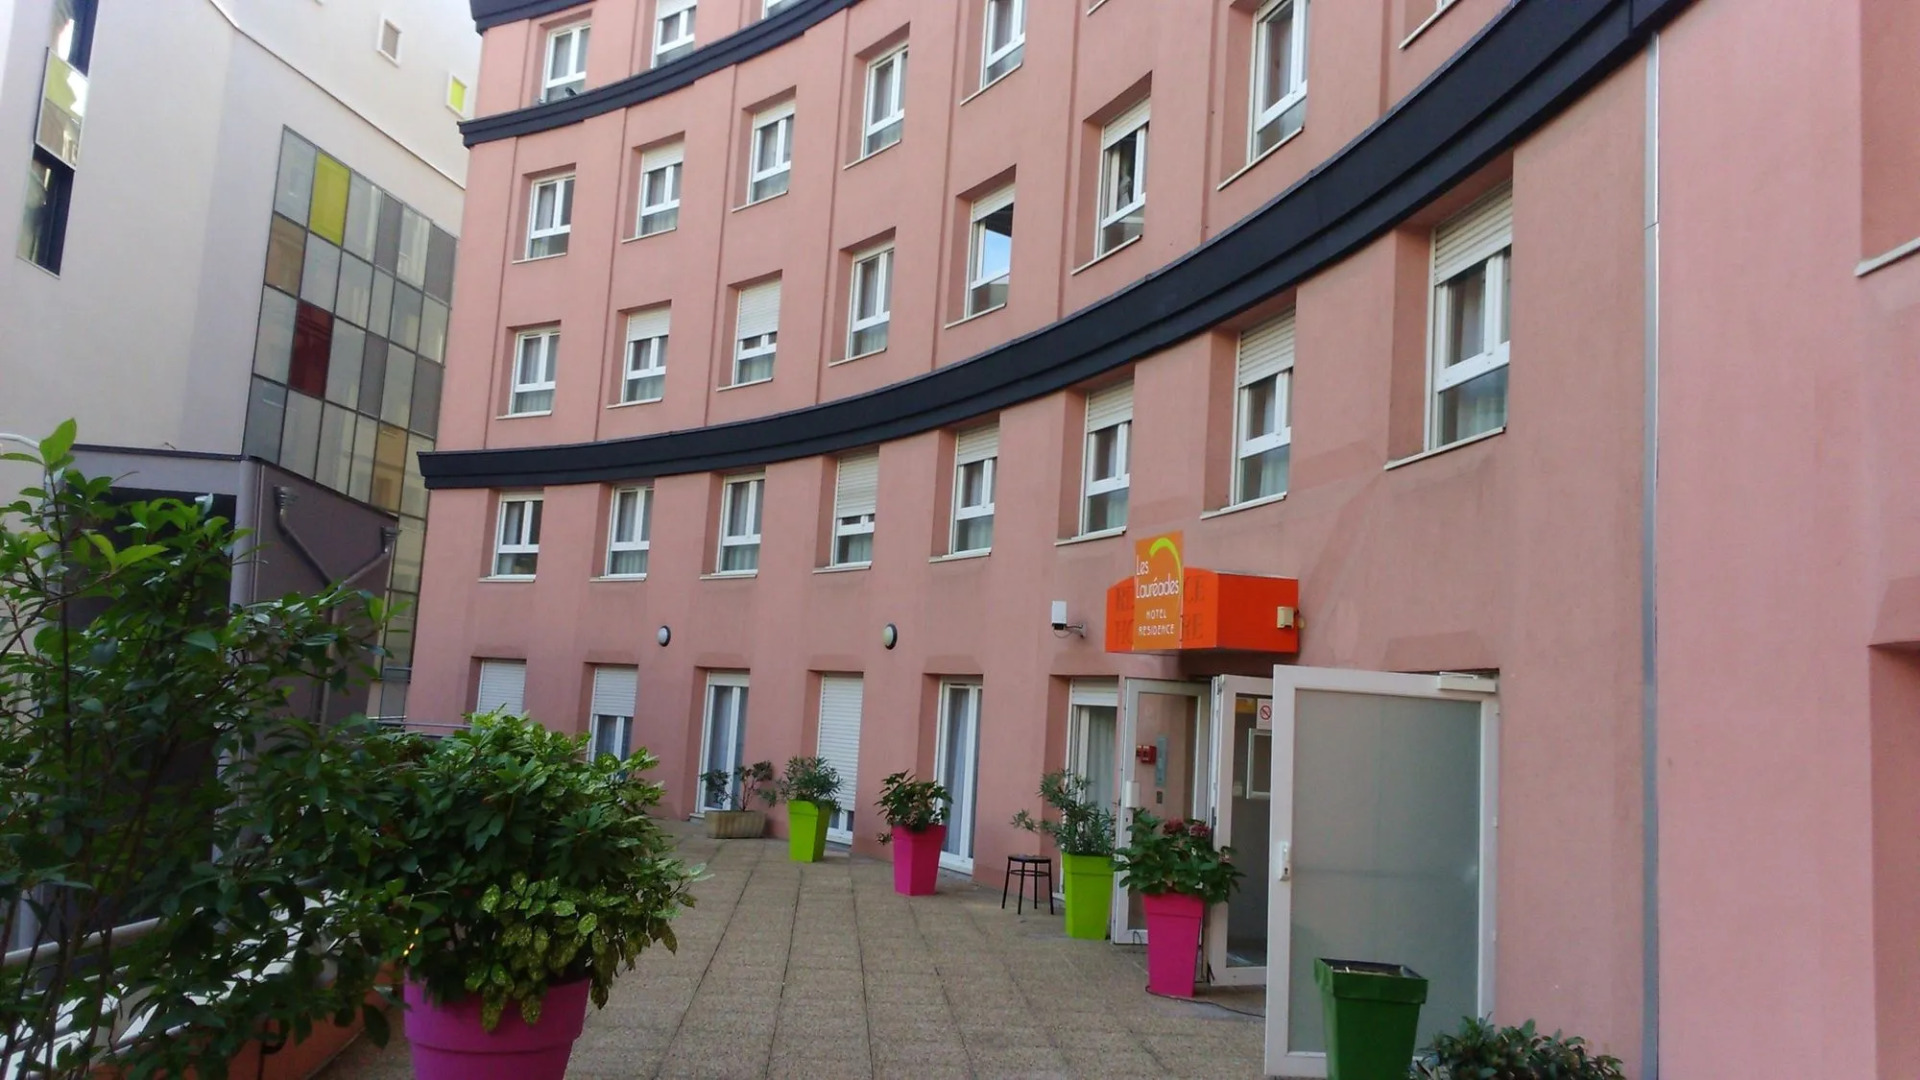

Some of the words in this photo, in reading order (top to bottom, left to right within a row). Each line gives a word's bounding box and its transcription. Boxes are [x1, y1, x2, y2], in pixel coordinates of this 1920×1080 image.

[1136, 555, 1149, 576] Les
[1136, 573, 1179, 599] Lauréades
[1146, 608, 1167, 620] HOTEL
[1138, 623, 1175, 636] RESIDENCE
